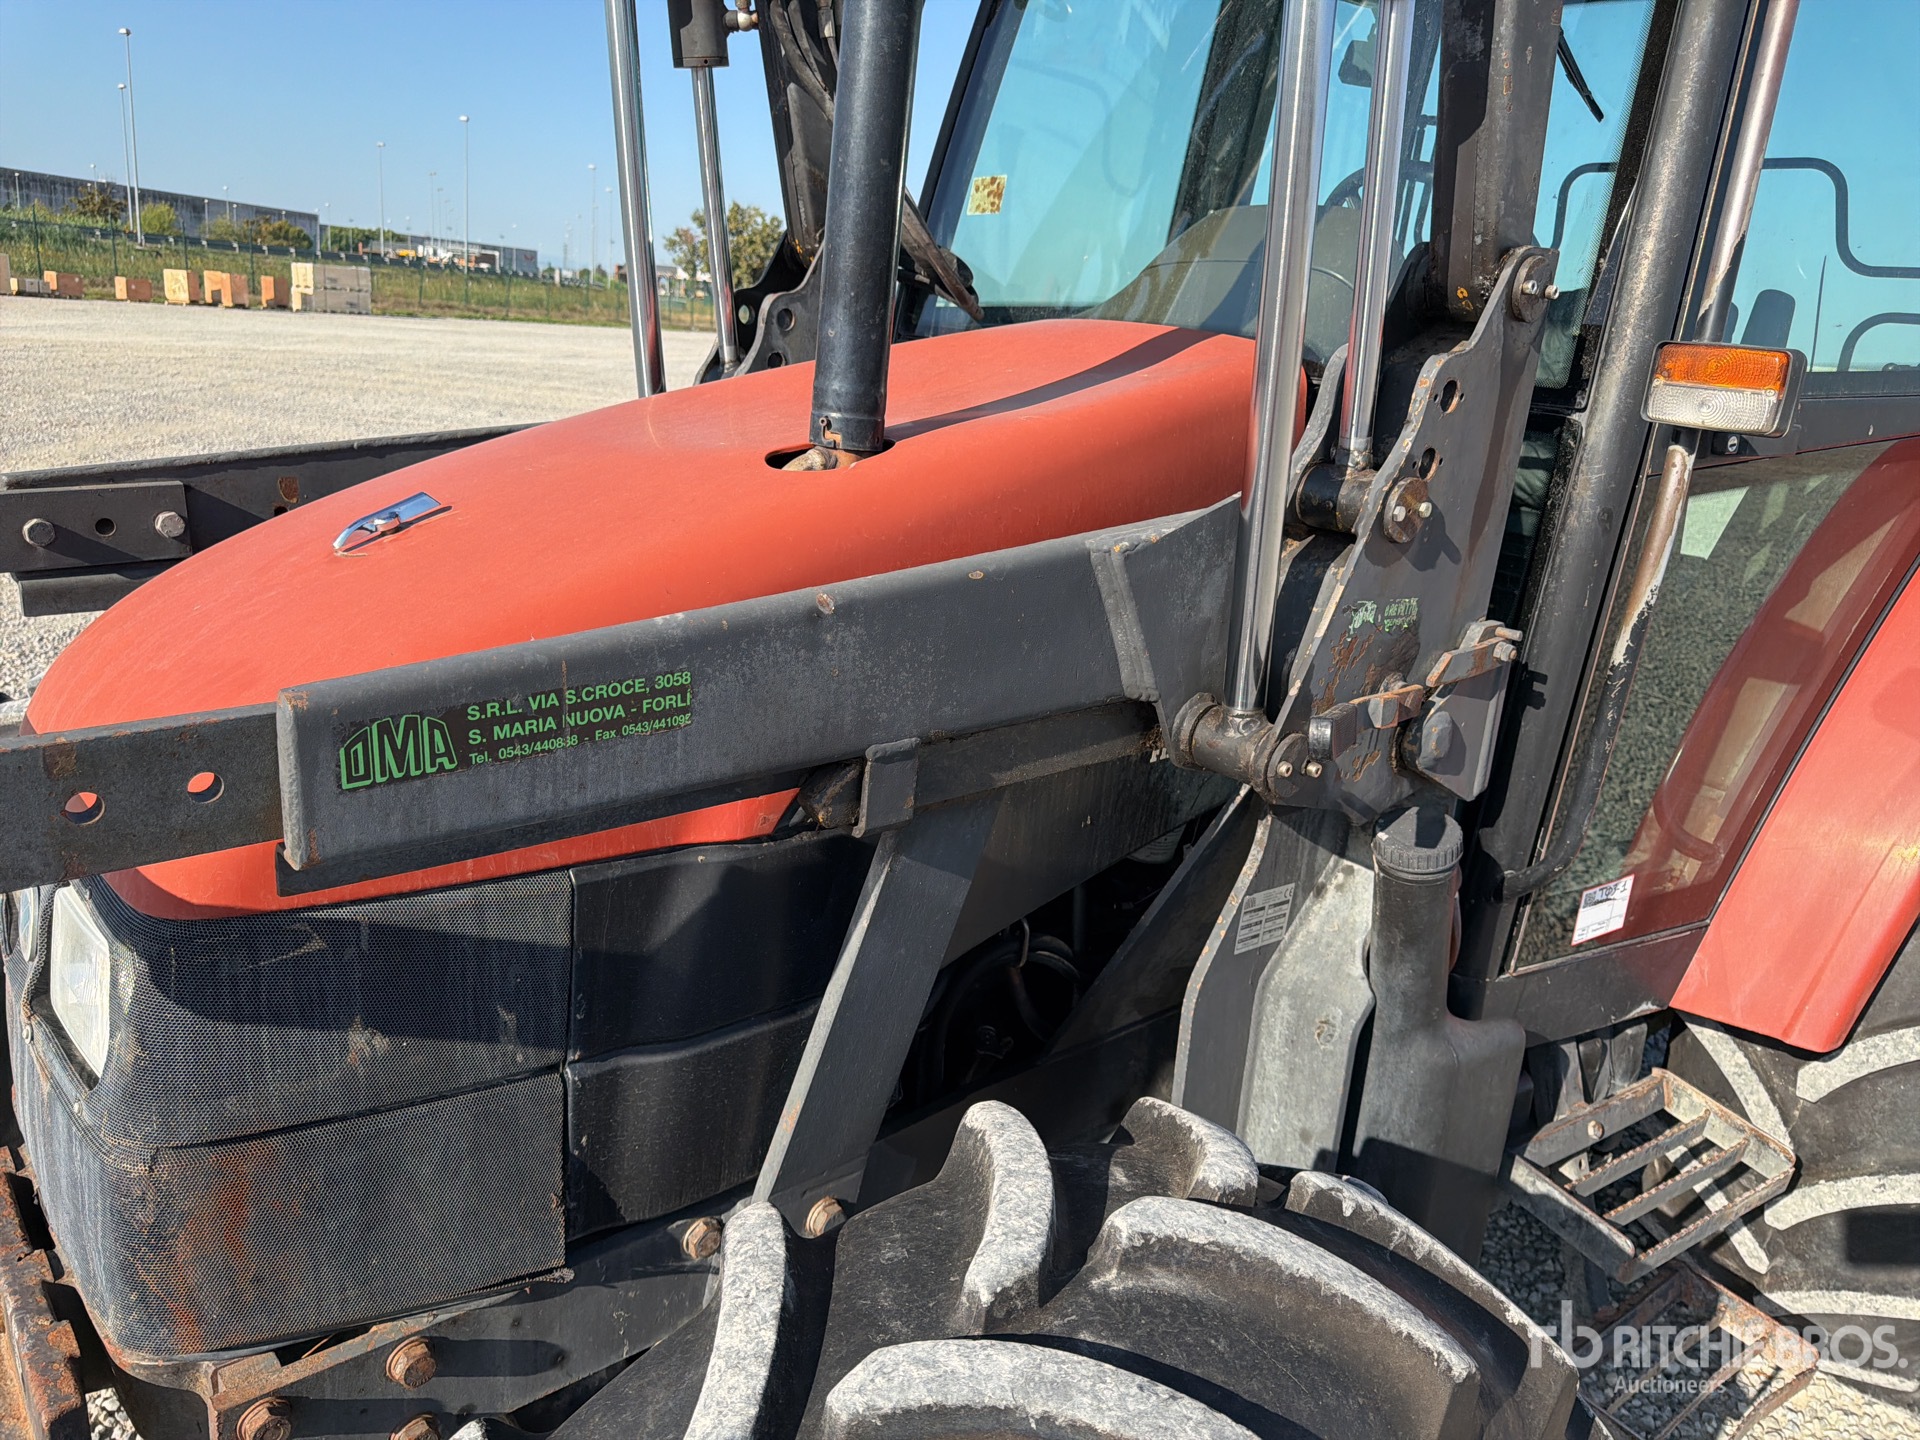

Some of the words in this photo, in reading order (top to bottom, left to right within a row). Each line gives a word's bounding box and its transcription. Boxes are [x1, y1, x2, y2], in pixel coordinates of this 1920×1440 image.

[467, 700, 523, 721] S.R.L.
[528, 692, 560, 711] VIA
[565, 679, 650, 704] S.CROCE,
[654, 671, 692, 690] 3058
[468, 729, 487, 745] S.
[493, 716, 557, 741] MARIA
[562, 703, 626, 729] NUOVA
[339, 714, 458, 790] OMA
[469, 751, 493, 766] Tel.
[595, 729, 617, 741] Fax
